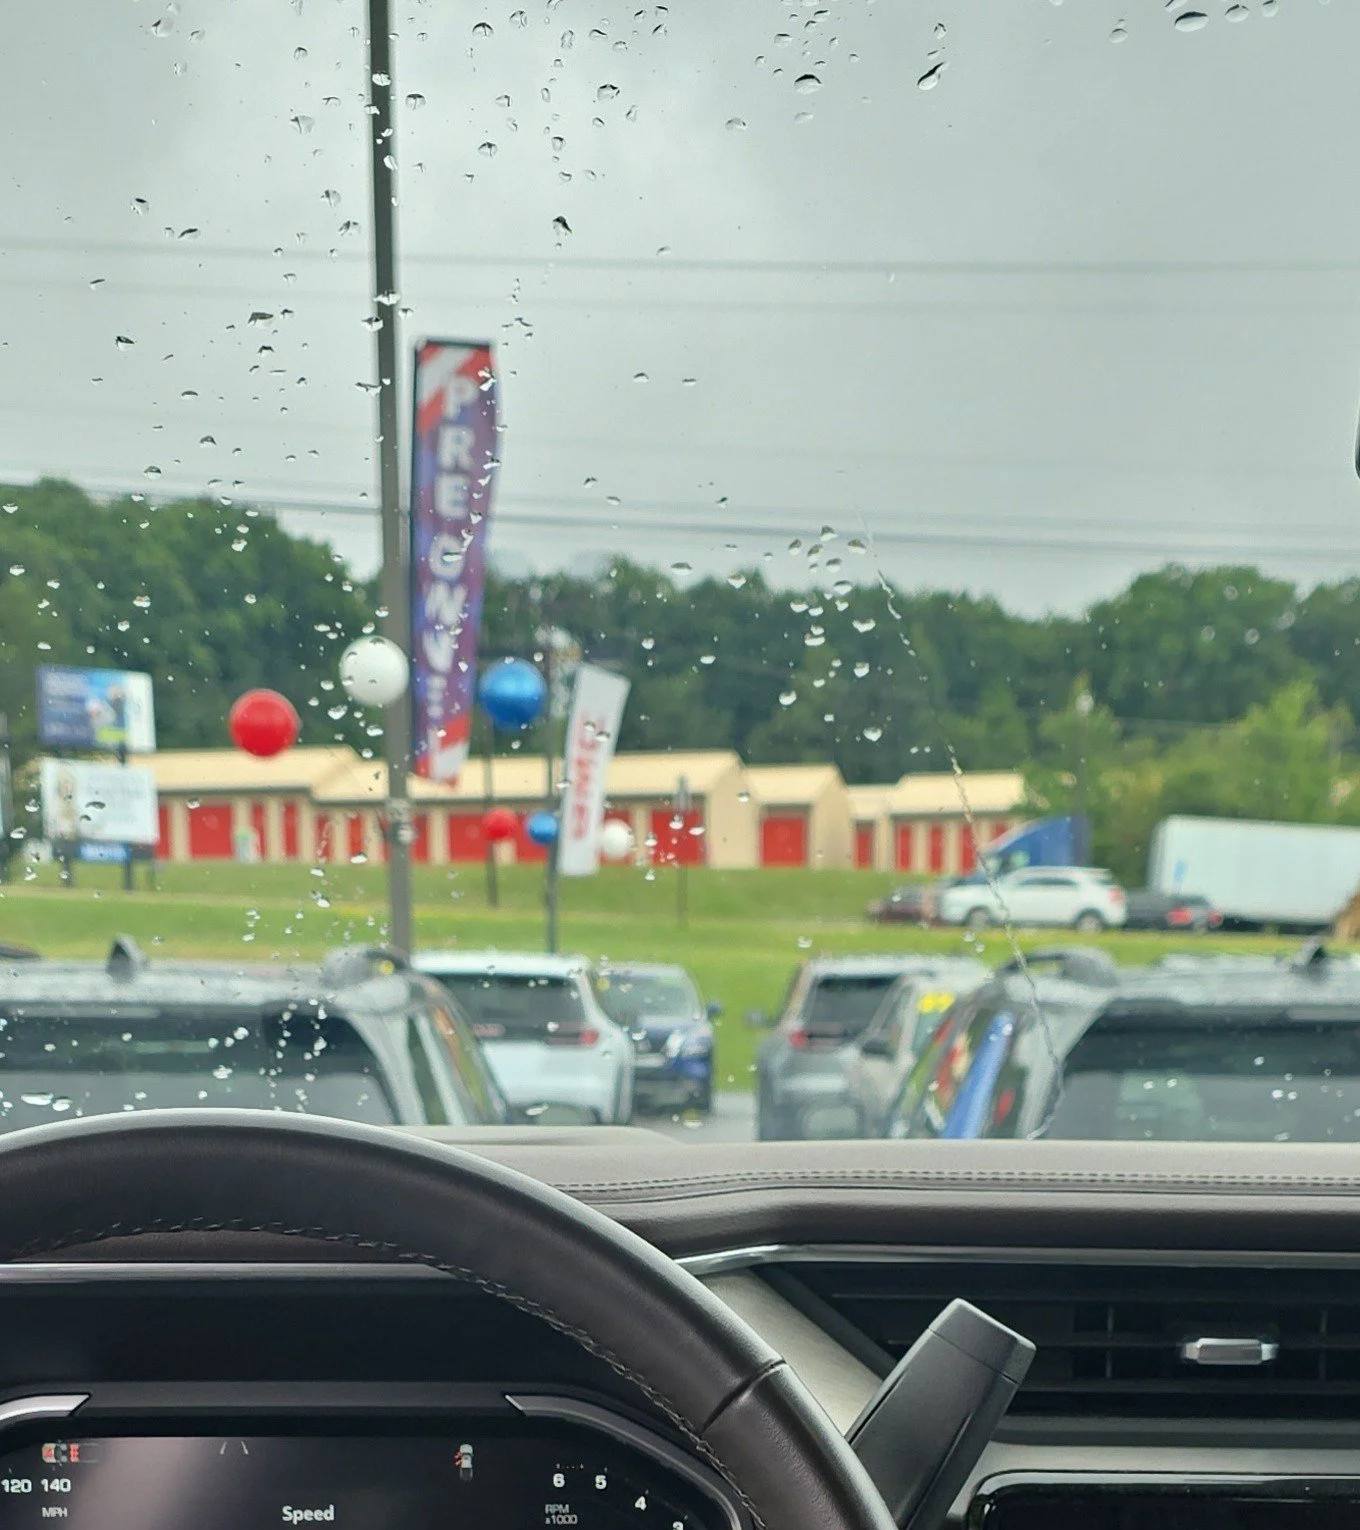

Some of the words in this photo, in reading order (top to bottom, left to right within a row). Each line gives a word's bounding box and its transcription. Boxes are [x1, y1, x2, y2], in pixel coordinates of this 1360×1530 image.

[1, 1479, 32, 1493] 120
[41, 1478, 71, 1493] 140
[553, 1473, 566, 1488] 6
[595, 1475, 607, 1490] 5
[545, 1504, 569, 1514] RPM
[634, 1496, 647, 1511] 4
[42, 1507, 68, 1518] MPH
[282, 1504, 335, 1525] Speed
